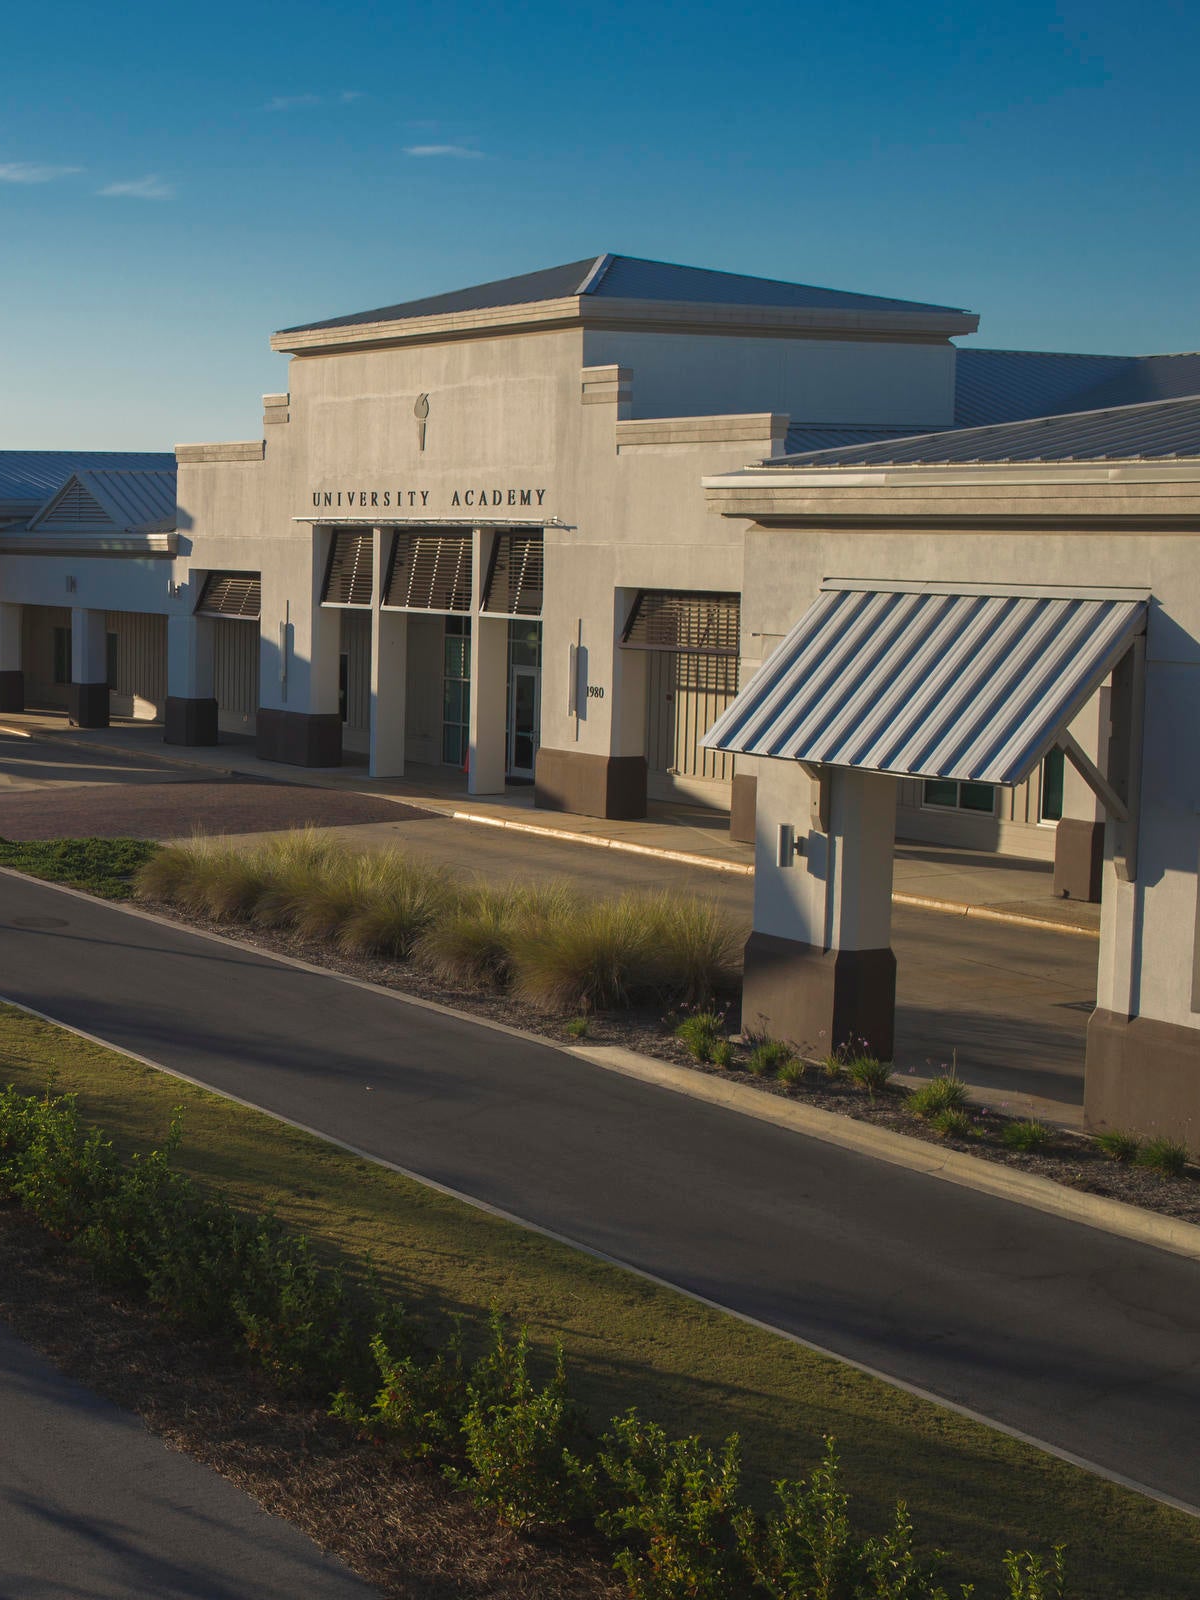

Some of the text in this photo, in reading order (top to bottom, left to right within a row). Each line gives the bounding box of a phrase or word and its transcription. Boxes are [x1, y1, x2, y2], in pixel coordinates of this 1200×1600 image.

[312, 489, 546, 507] UNIVERSITY ACADEMY
[586, 686, 604, 699] 1980
